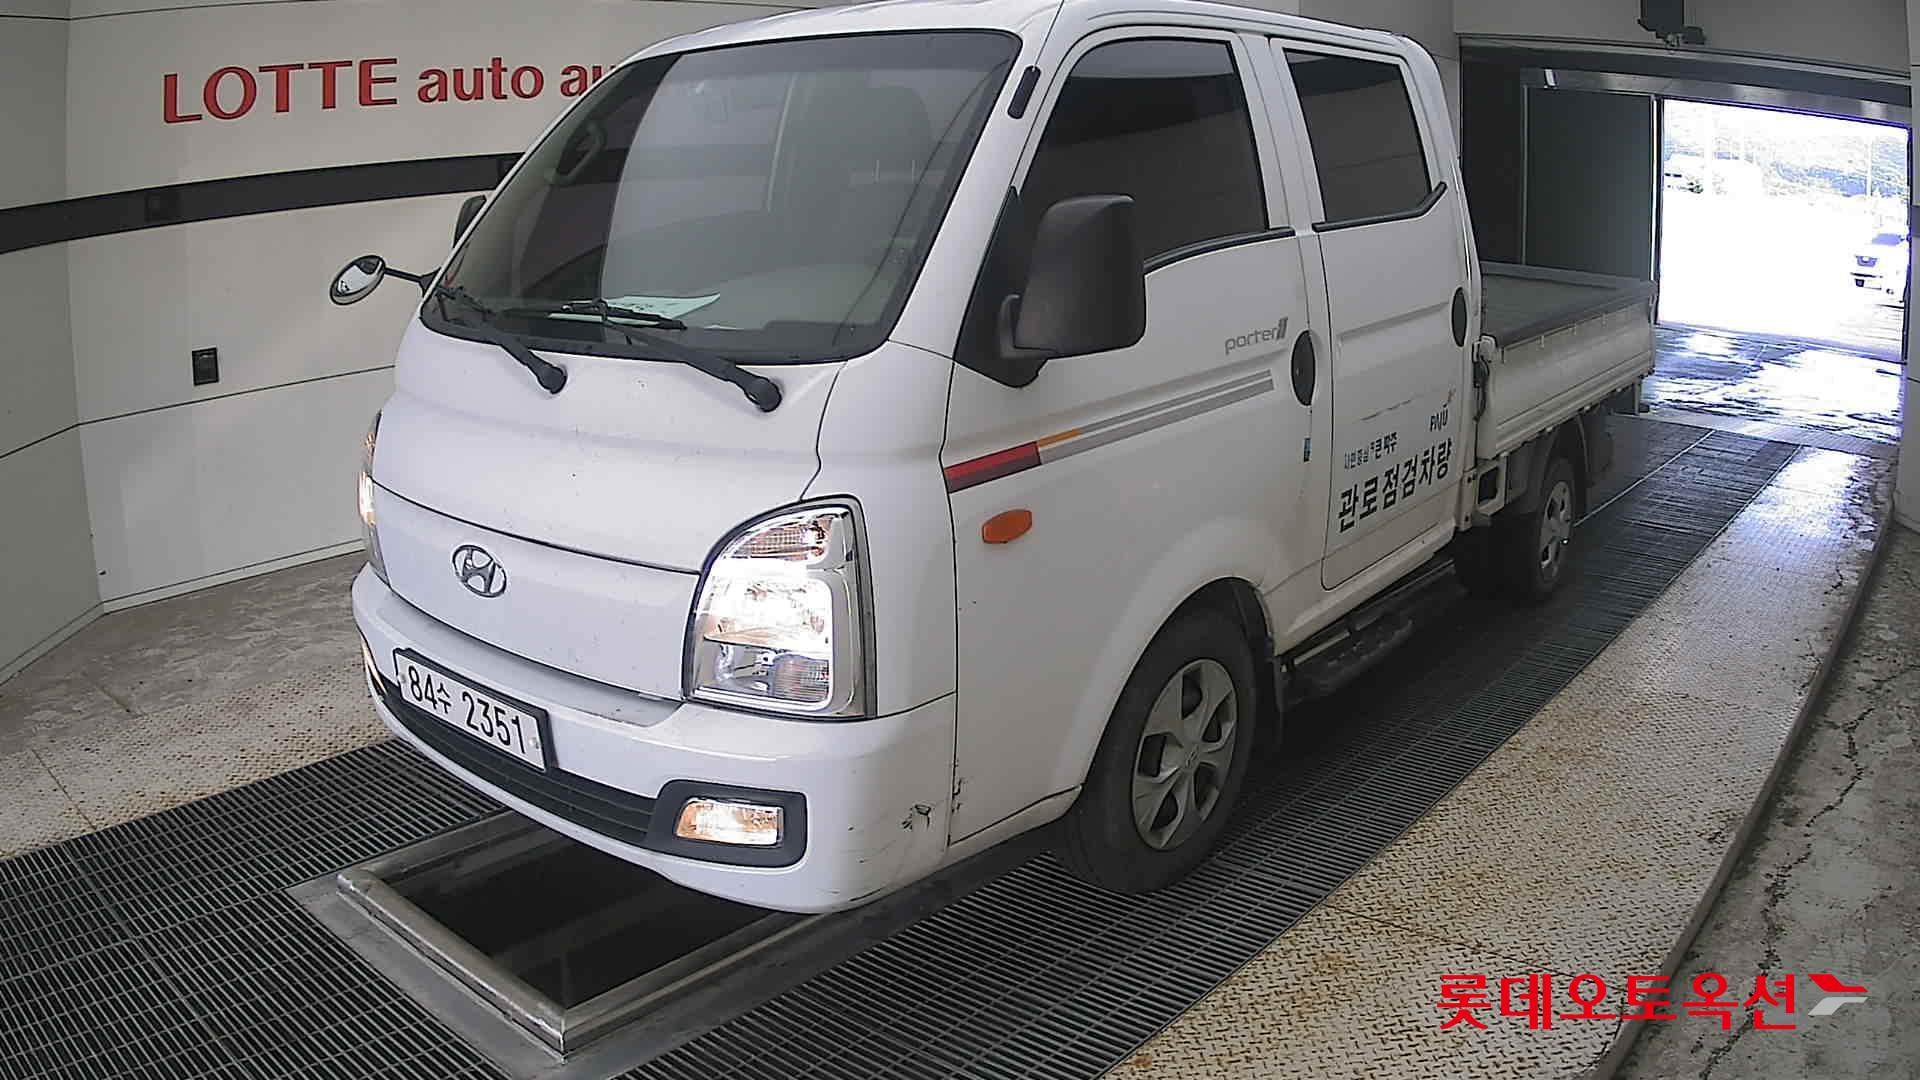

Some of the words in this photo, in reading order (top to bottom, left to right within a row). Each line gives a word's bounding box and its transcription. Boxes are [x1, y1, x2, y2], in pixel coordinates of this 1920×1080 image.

[163, 57, 398, 124] LOTTE
[417, 57, 545, 103] auto
[1338, 437, 1453, 534] 관로점검차량
[408, 665, 452, 715] 84수
[462, 691, 526, 755] 2351
